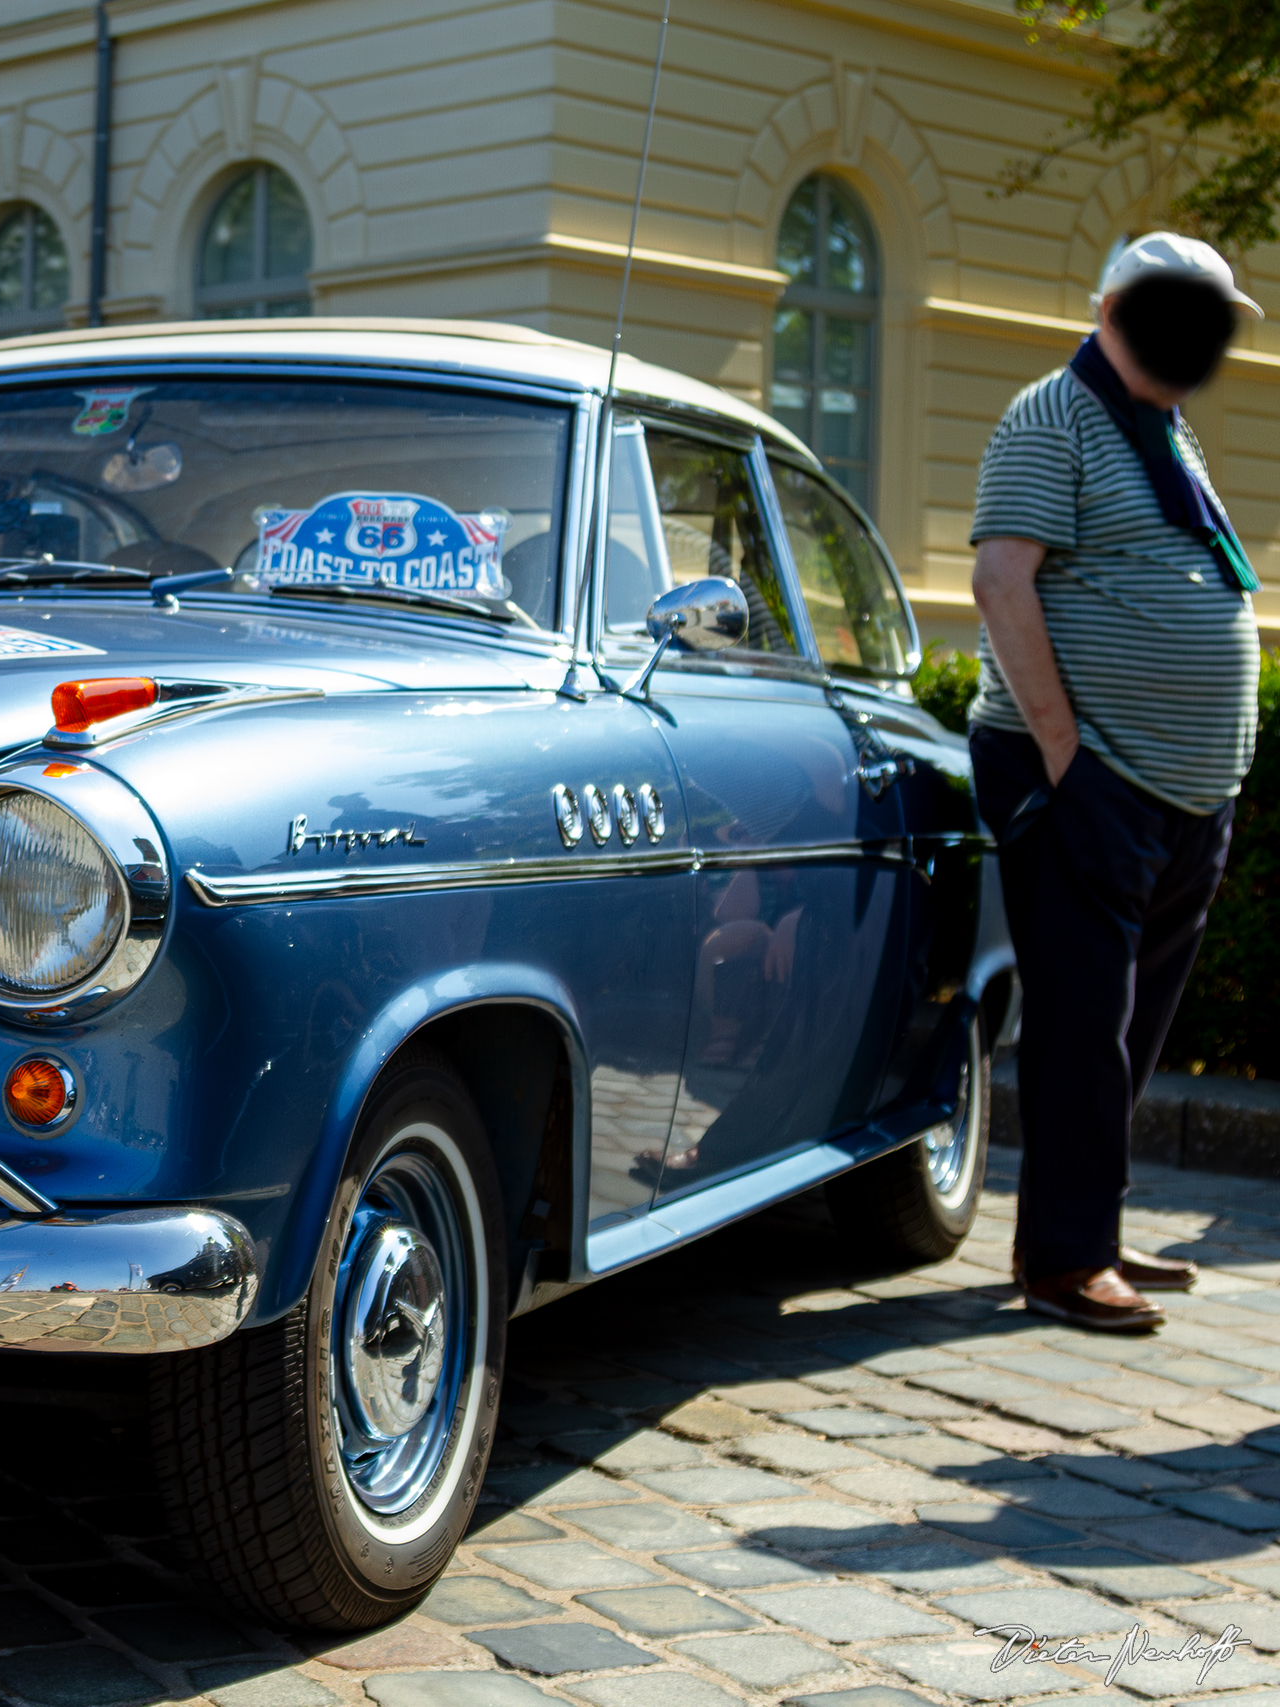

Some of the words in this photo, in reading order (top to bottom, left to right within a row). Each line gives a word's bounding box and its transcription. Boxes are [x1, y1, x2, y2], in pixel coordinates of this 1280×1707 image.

[357, 525, 405, 549] 66
[267, 538, 354, 584] COAST
[360, 560, 398, 585] TO
[404, 543, 495, 588] COAST
